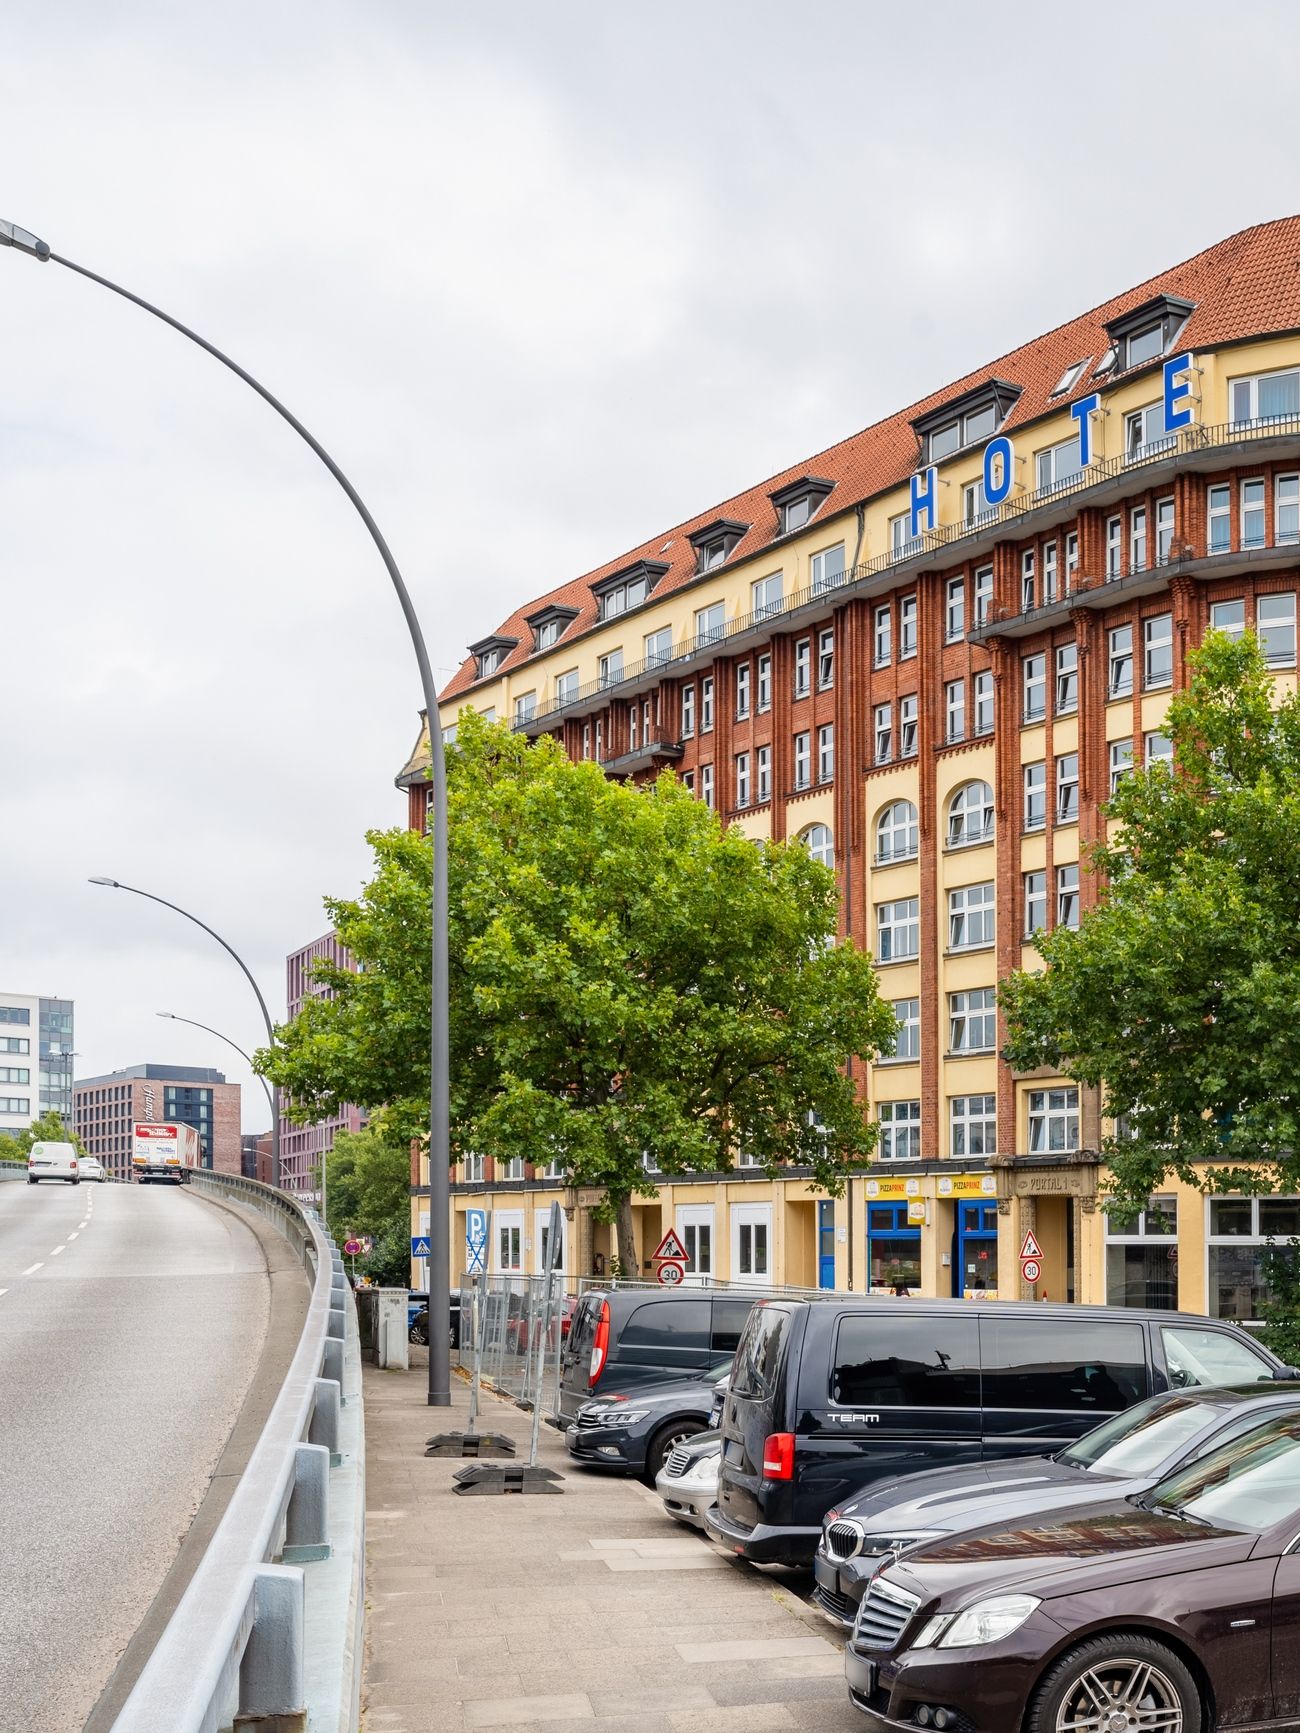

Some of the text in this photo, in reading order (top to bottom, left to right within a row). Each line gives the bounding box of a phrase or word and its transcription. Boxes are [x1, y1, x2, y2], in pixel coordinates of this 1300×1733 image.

[1030, 1178, 1062, 1190] PORTAL
[471, 1213, 482, 1242] P
[663, 1269, 678, 1281] 30
[1026, 1266, 1037, 1276] 30
[827, 1414, 880, 1422] TEAM
